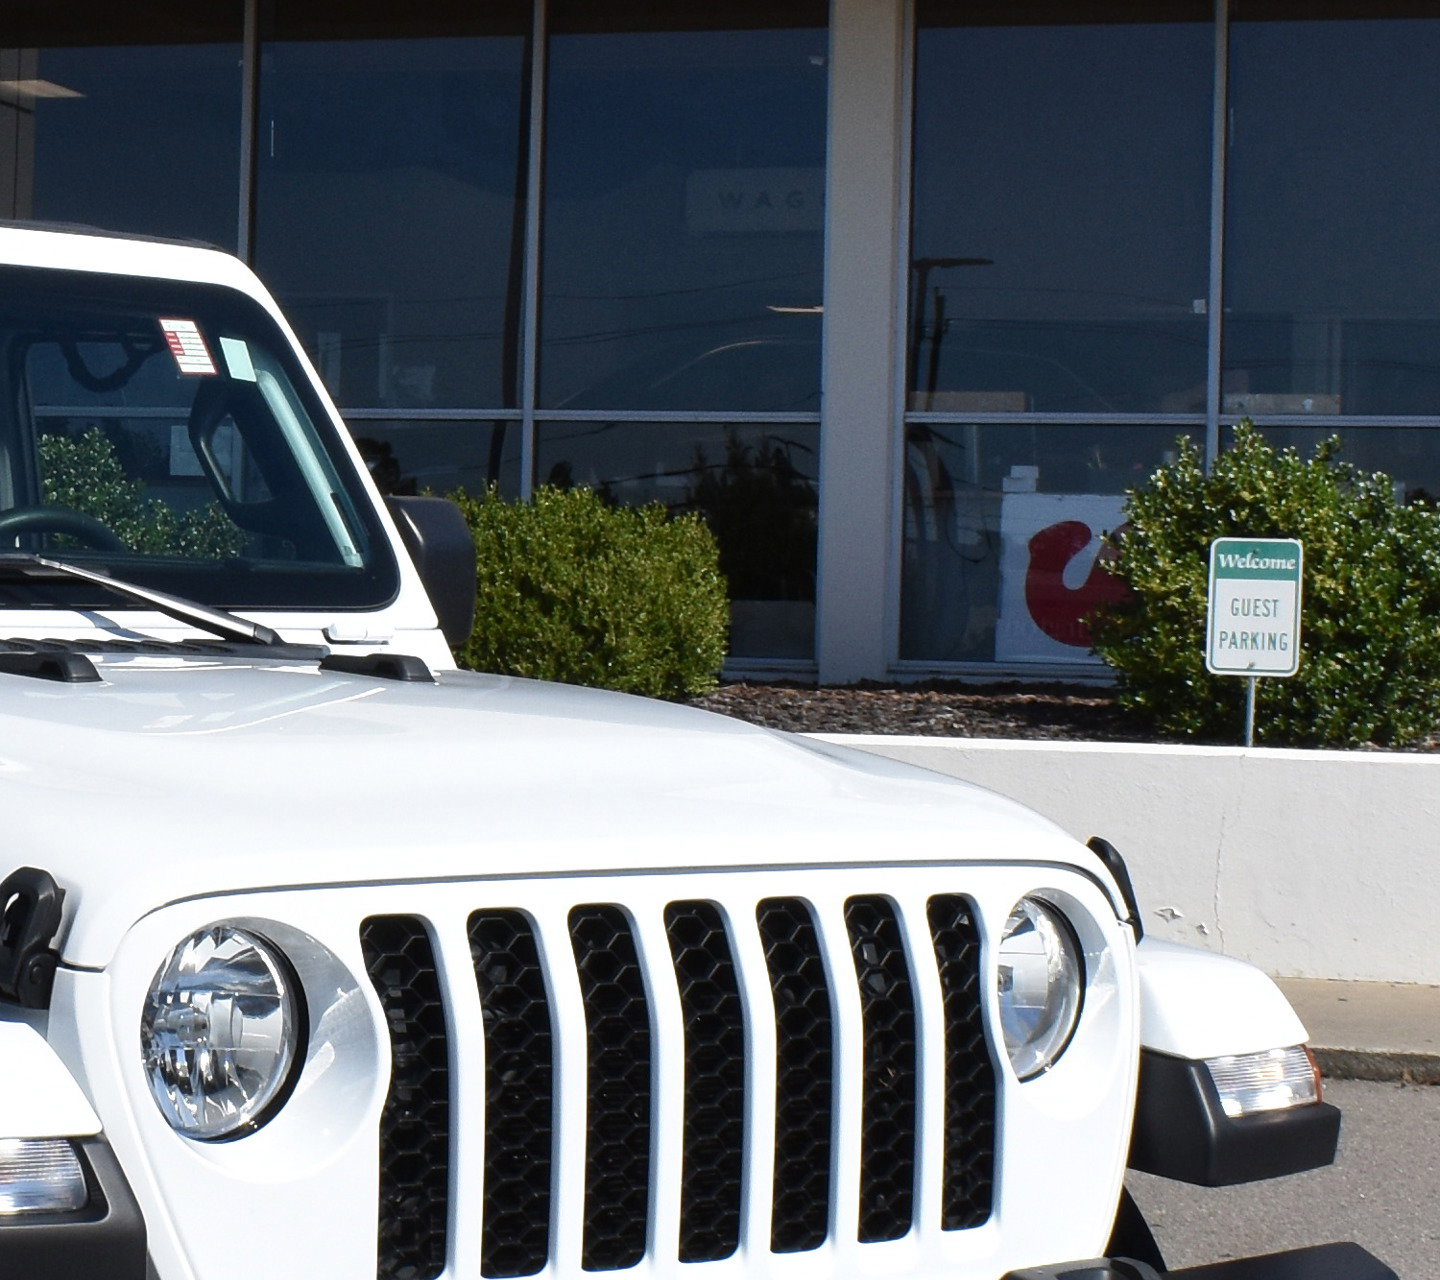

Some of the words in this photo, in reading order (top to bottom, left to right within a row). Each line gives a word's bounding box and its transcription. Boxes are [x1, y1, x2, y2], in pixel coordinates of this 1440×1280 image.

[1218, 552, 1296, 570] Welcome
[1231, 598, 1280, 617] GUEST
[1218, 631, 1288, 651] PARKING
